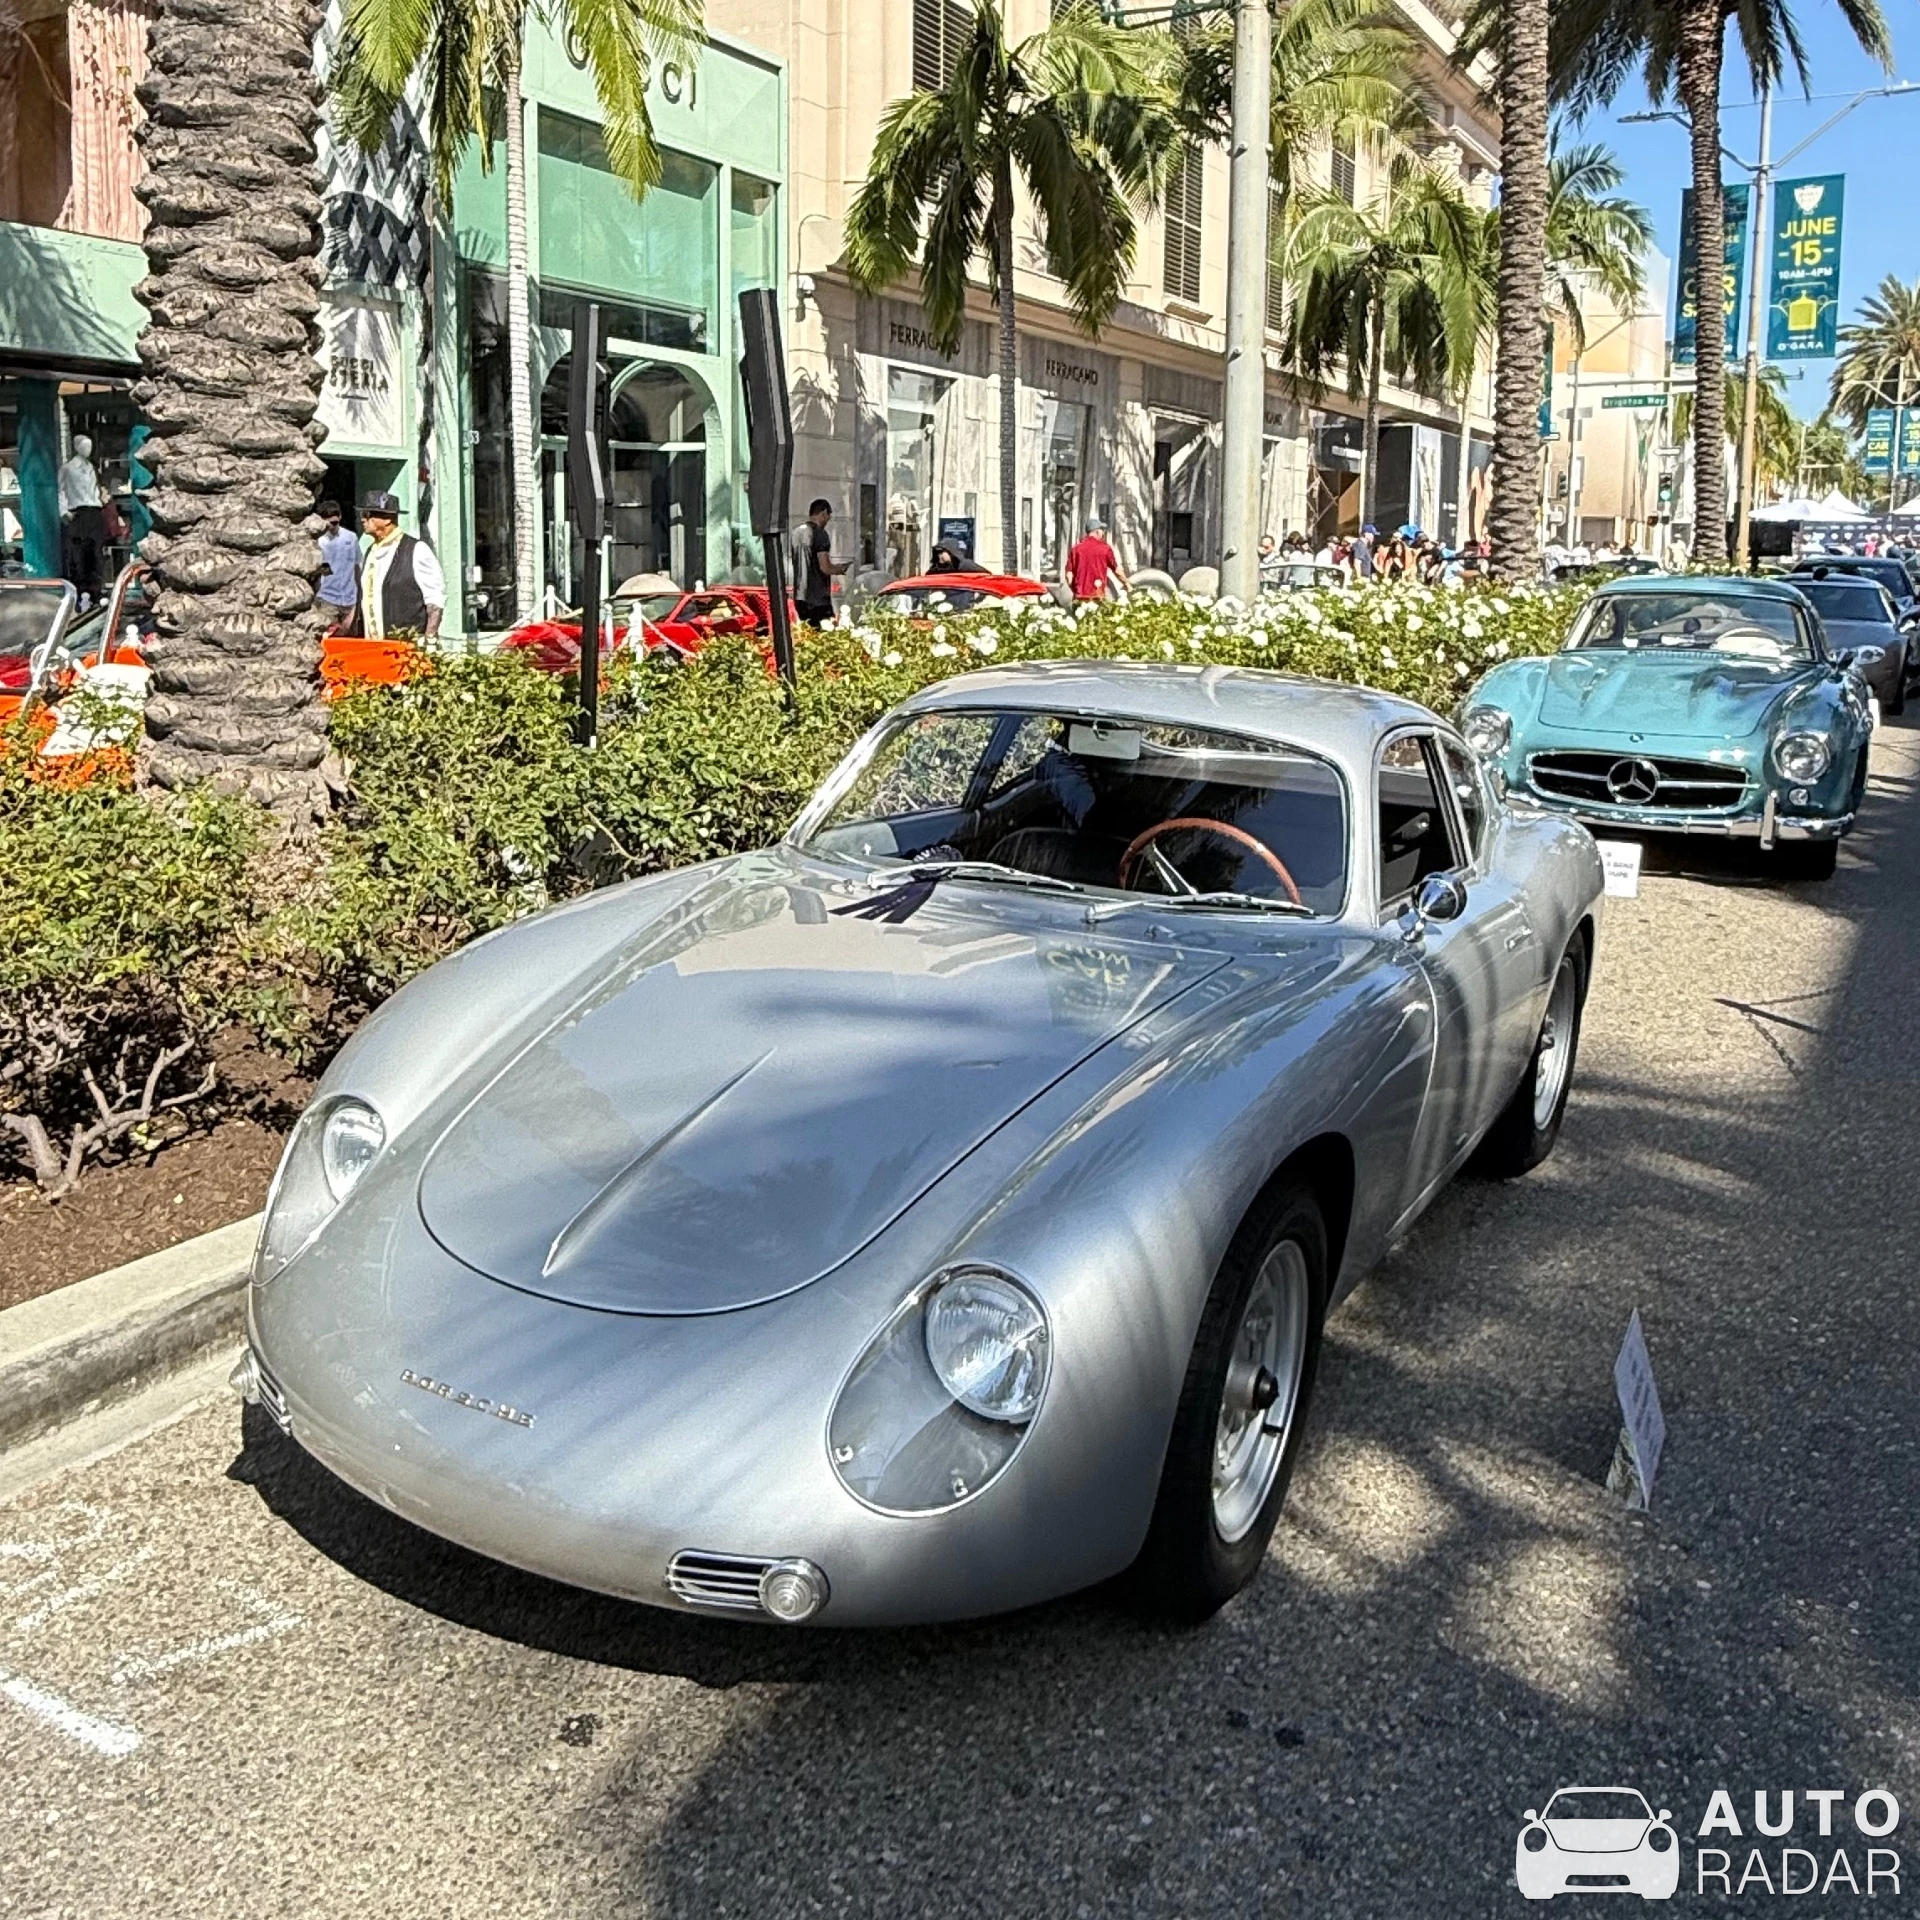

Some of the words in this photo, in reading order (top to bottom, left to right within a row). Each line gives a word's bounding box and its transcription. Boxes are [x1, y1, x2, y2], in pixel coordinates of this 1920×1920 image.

[1779, 216, 1837, 238] JUNE
[1046, 359, 1099, 386] FERRAGAMO
[1647, 396, 1665, 406] Way
